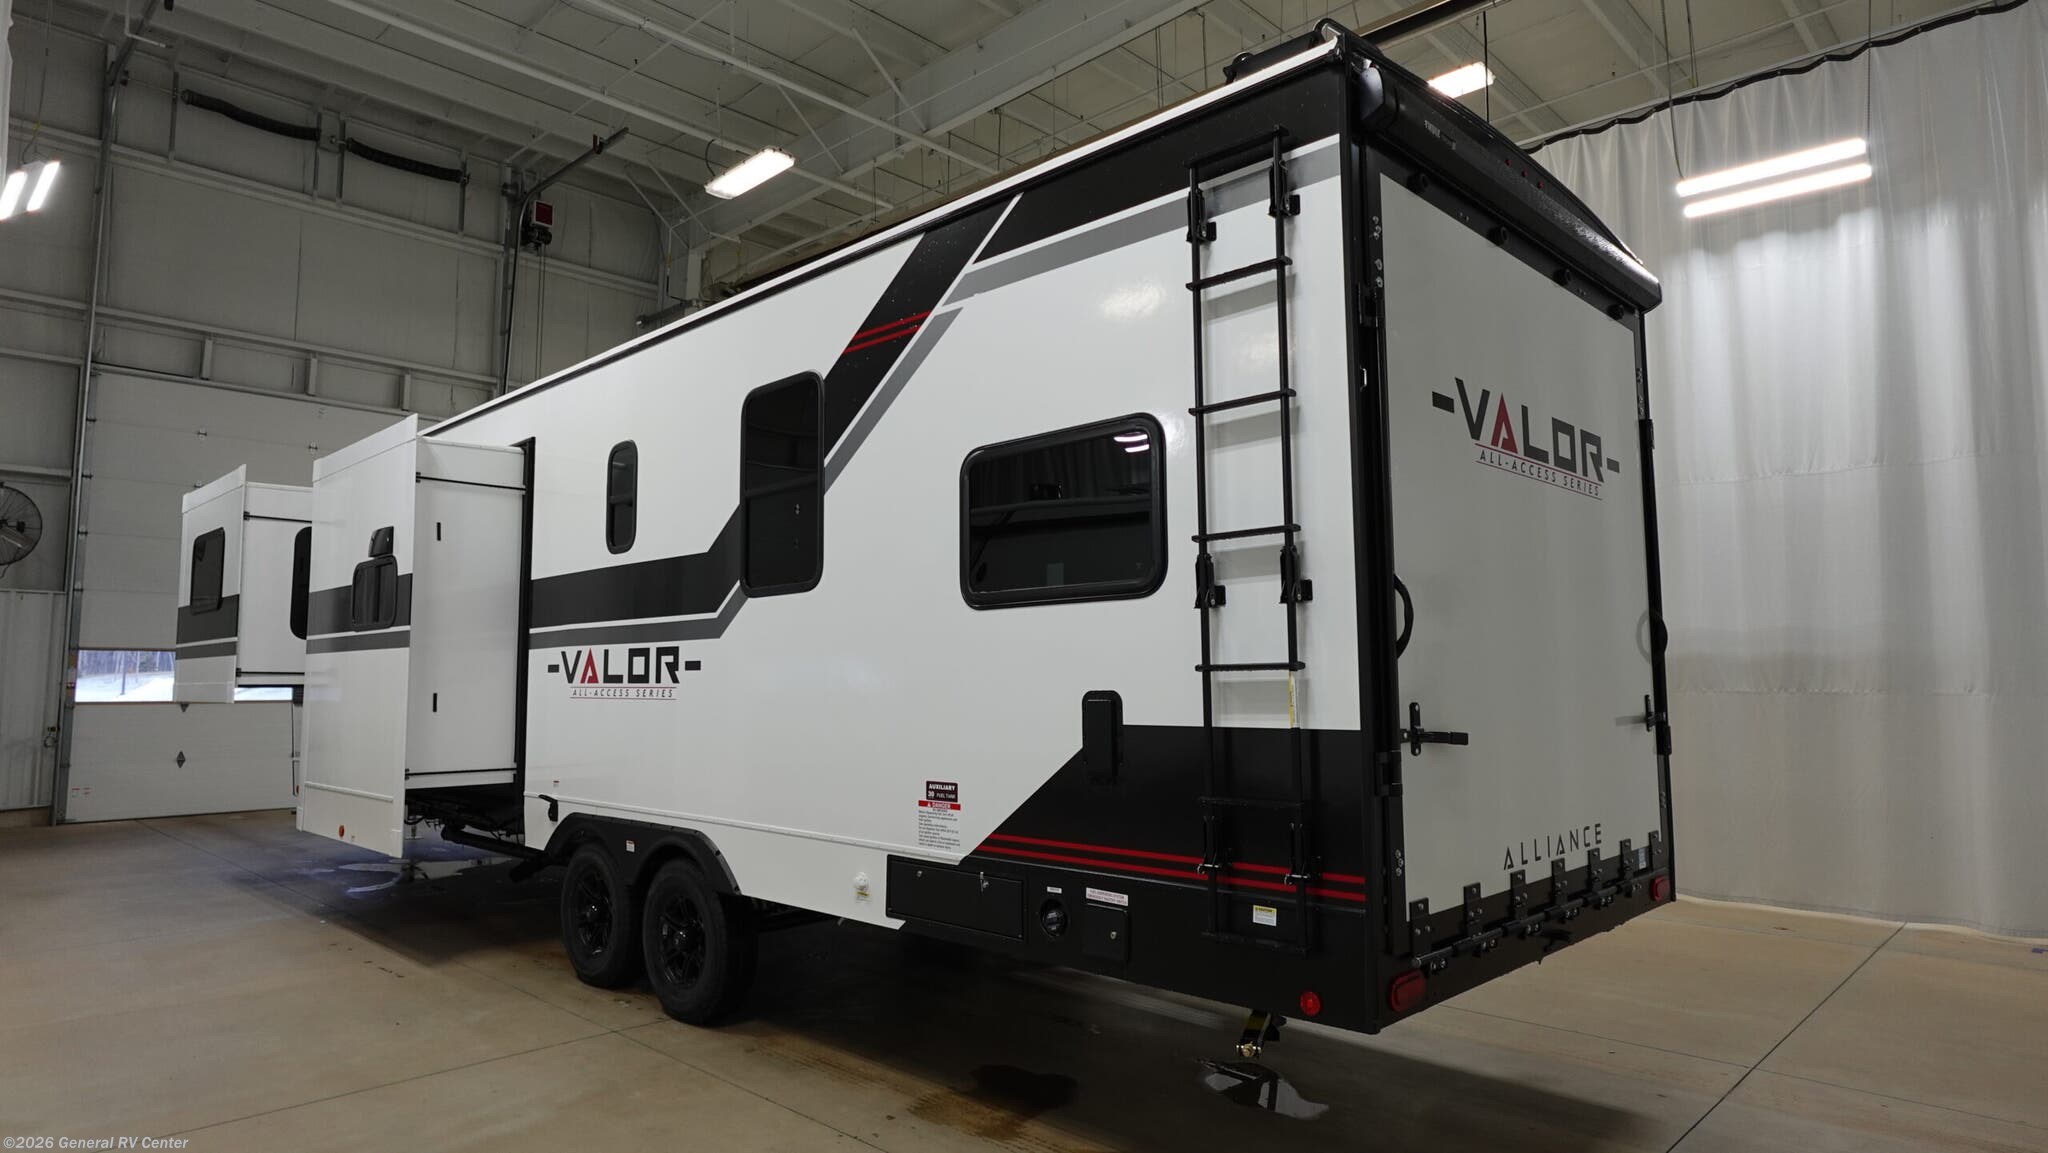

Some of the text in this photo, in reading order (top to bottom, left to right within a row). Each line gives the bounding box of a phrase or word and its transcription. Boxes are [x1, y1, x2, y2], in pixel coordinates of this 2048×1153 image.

[1479, 449, 1600, 497] ALL-ACCESS SERIES
[572, 688, 674, 699] ALL-ACCESS SERIES
[1504, 823, 1602, 870] ALLIANCE
